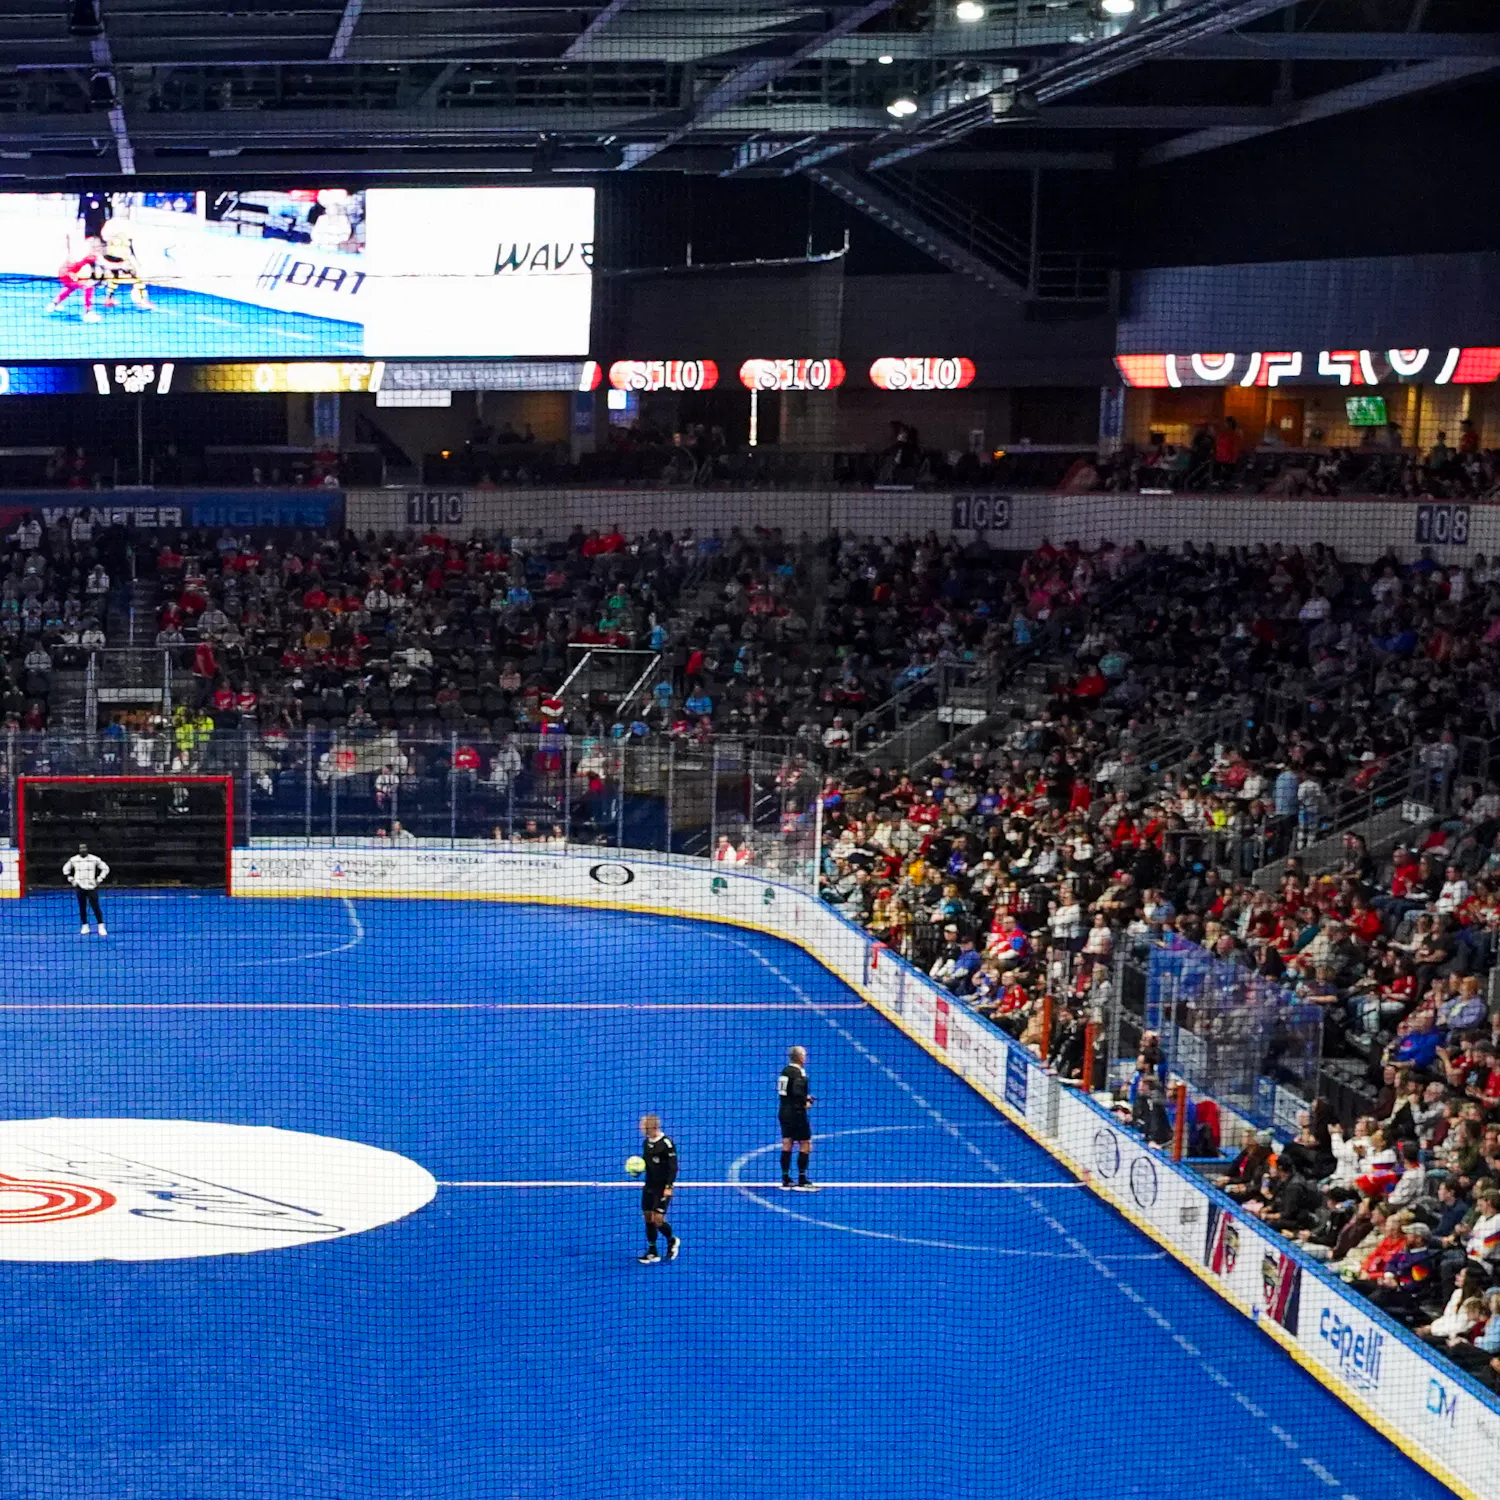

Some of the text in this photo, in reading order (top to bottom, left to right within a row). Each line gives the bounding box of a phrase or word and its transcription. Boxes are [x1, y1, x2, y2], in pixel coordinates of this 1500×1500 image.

[115, 365, 155, 383] 5:35
[410, 494, 461, 524] 110
[956, 496, 1010, 529] 109
[1419, 508, 1468, 543] 108
[1320, 1308, 1383, 1381] capelli
